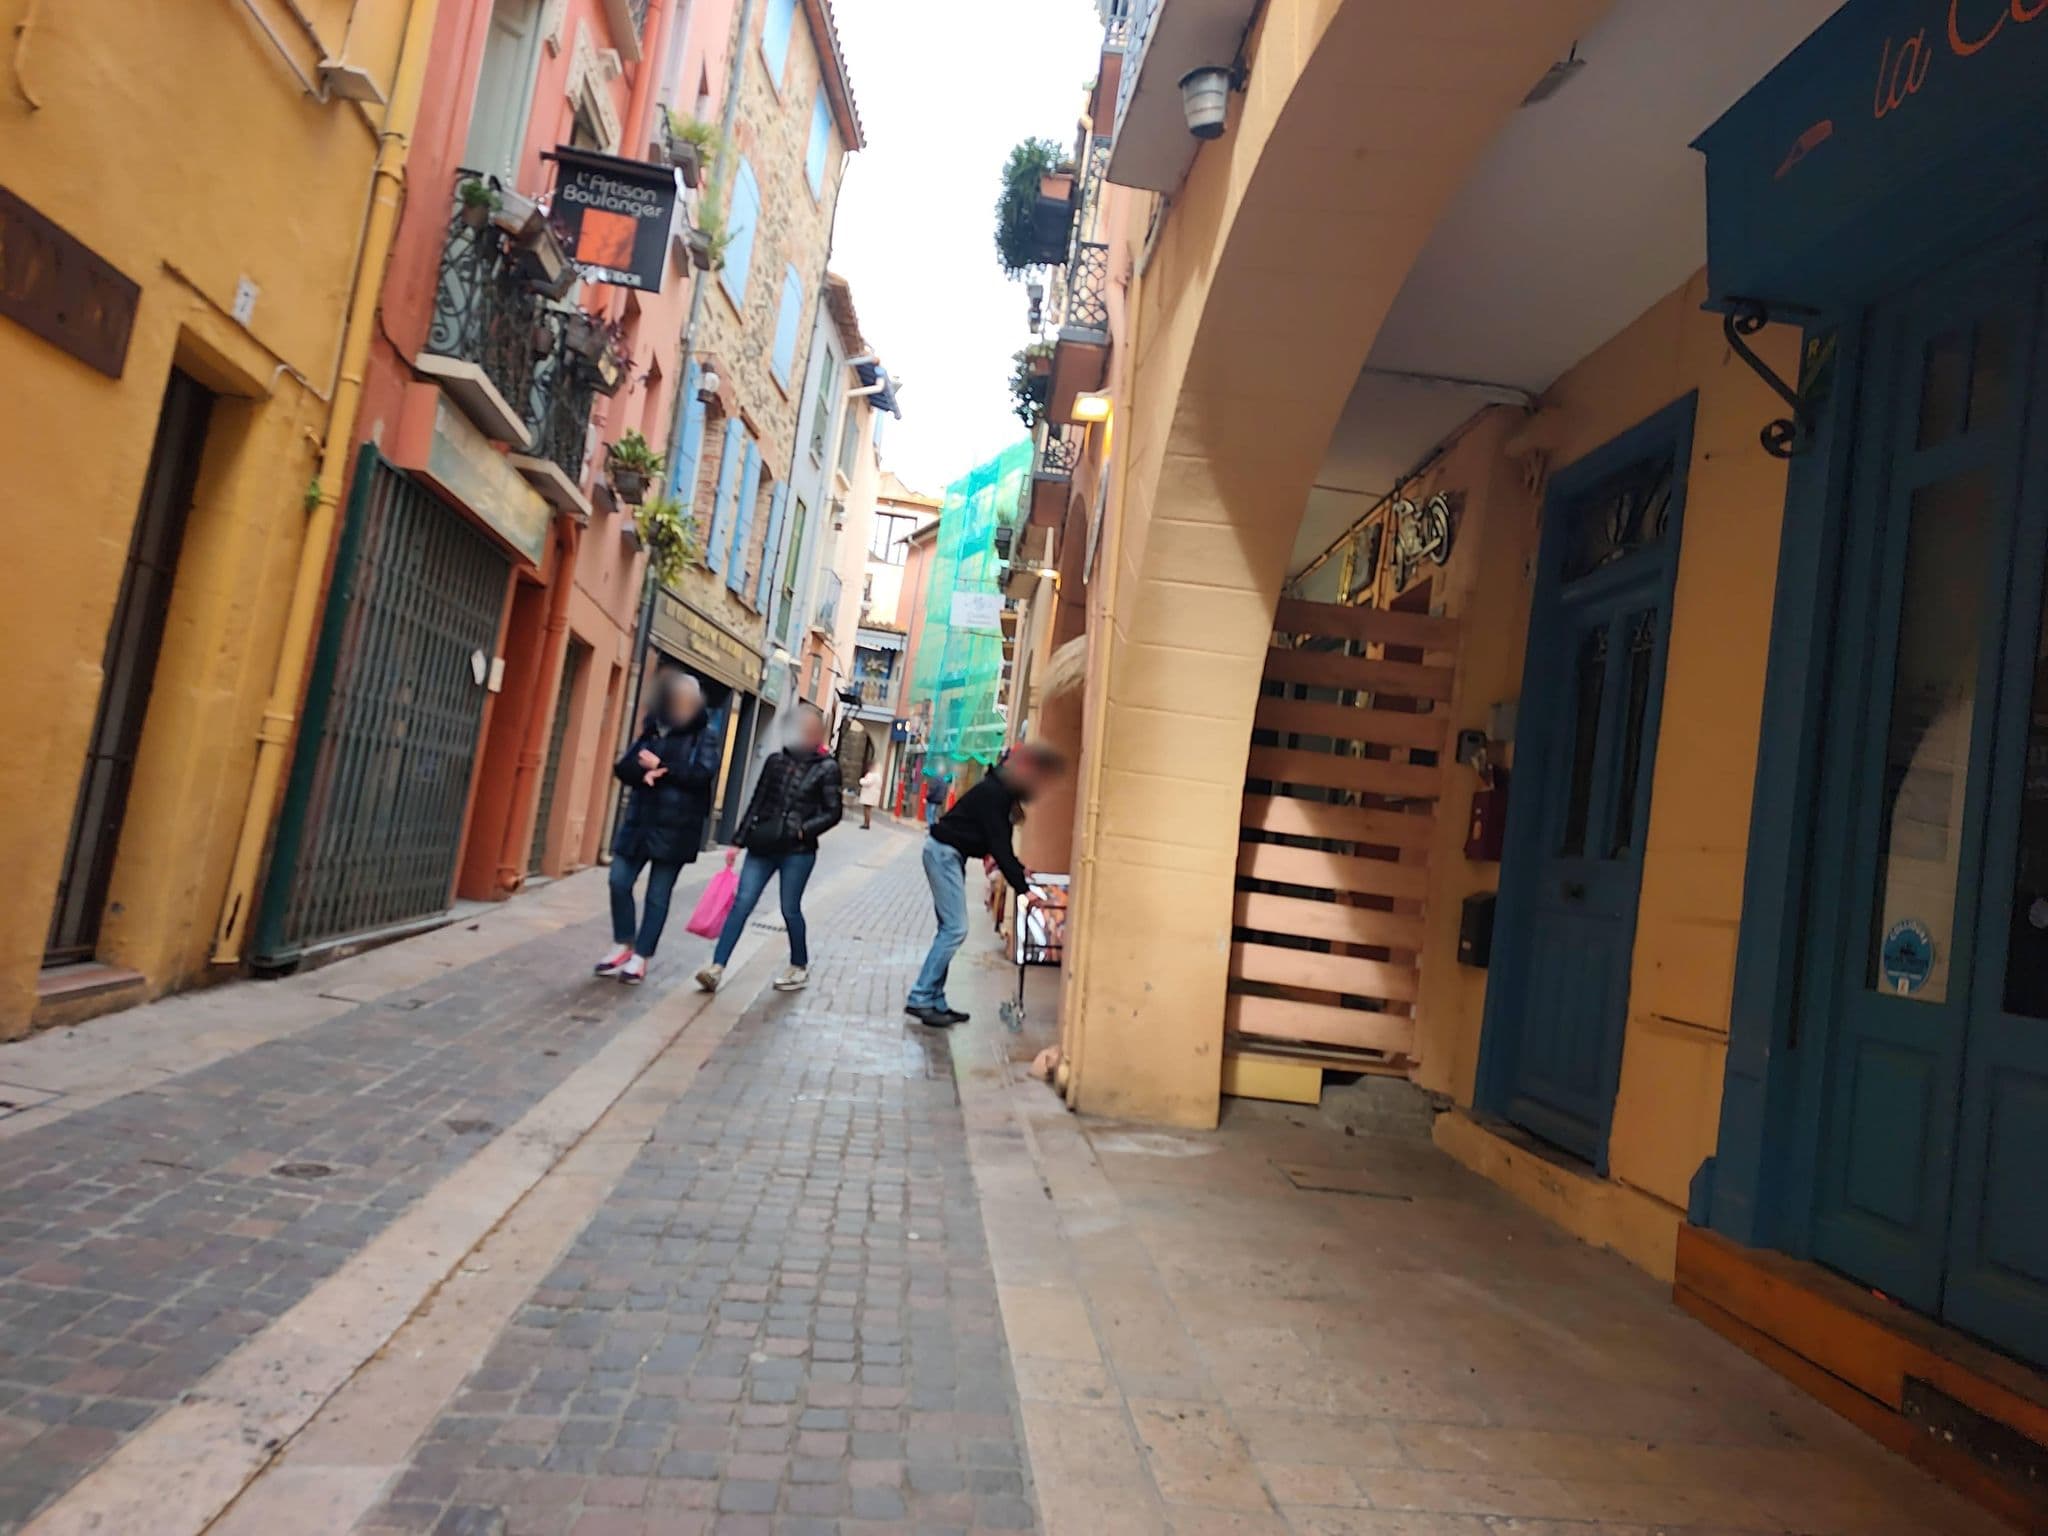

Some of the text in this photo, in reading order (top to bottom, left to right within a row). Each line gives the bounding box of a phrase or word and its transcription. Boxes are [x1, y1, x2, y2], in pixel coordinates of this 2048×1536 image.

[1874, 27, 1932, 119] la
[562, 183, 664, 219] Boulanger
[575, 171, 657, 203] L'Artisan
